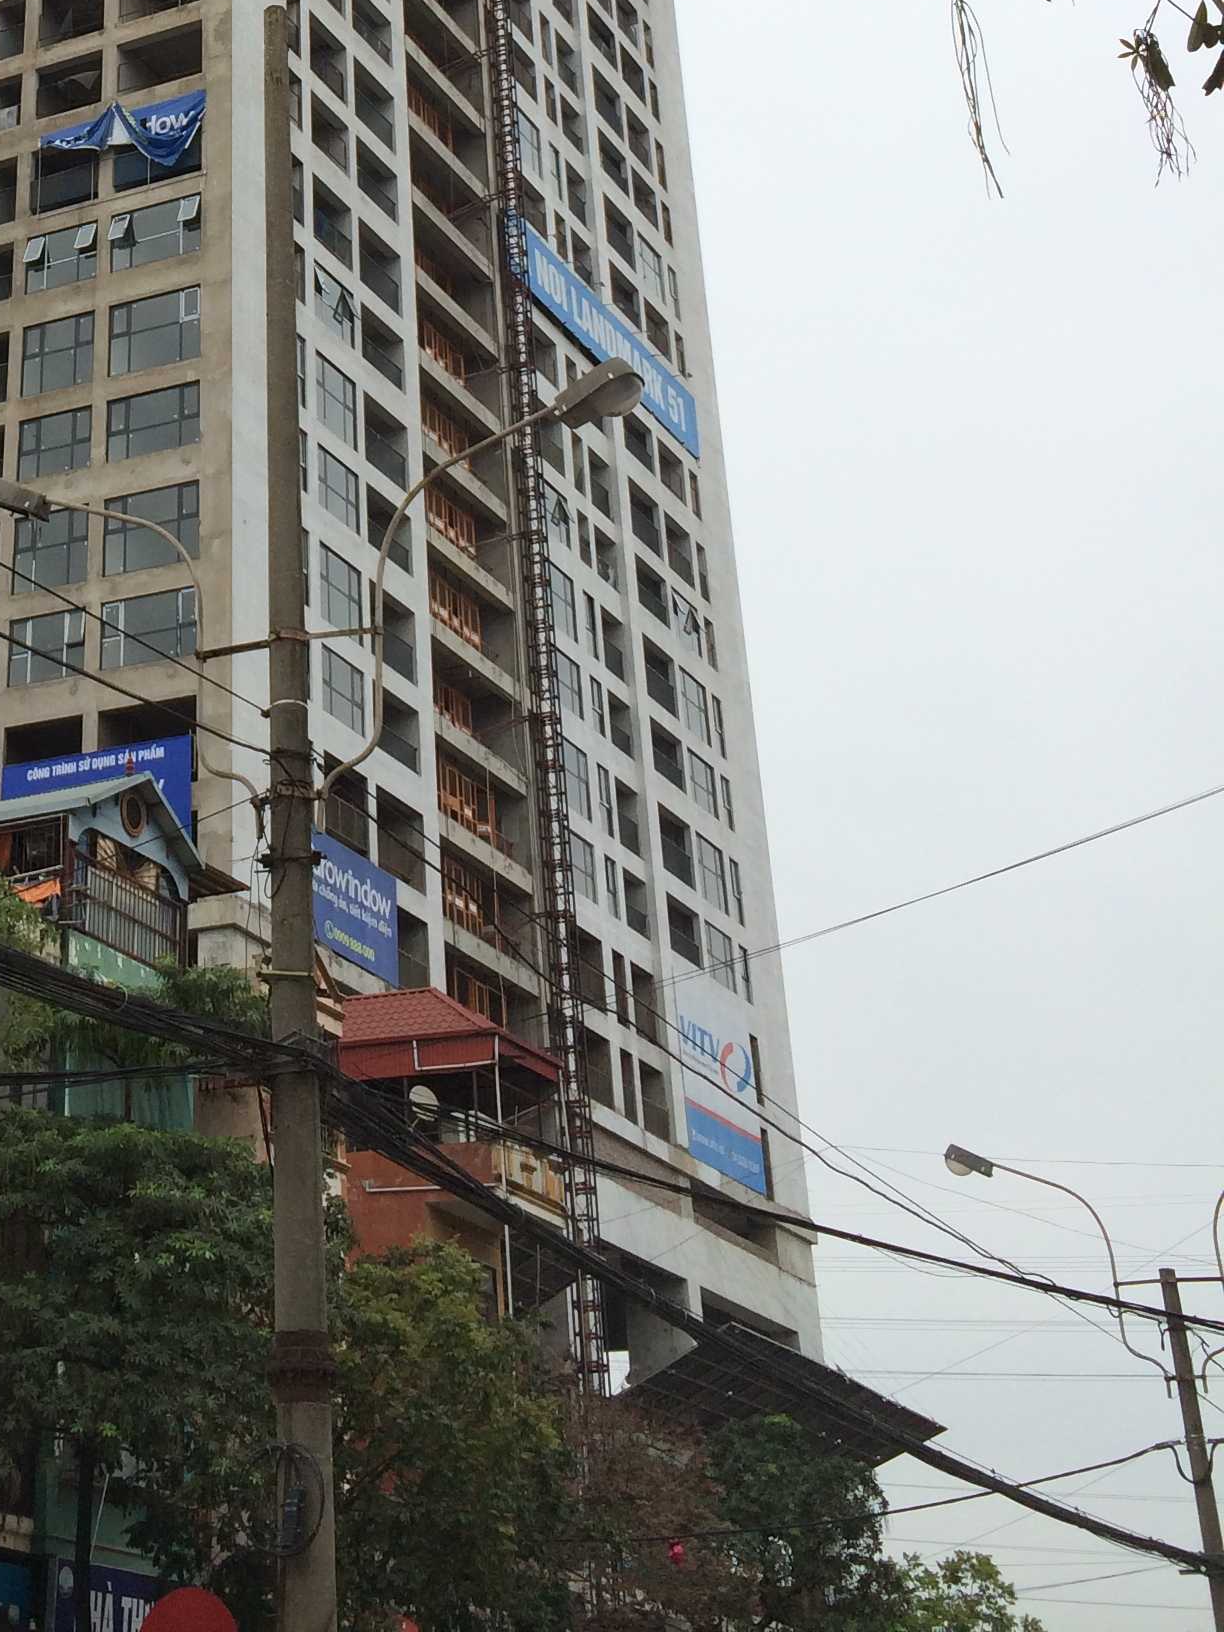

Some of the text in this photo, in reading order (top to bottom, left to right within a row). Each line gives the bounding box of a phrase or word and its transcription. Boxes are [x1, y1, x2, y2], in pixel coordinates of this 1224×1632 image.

[666, 384, 687, 433] 51
[26, 766, 51, 782] CÔNG
[89, 1581, 114, 1632] HÀ
